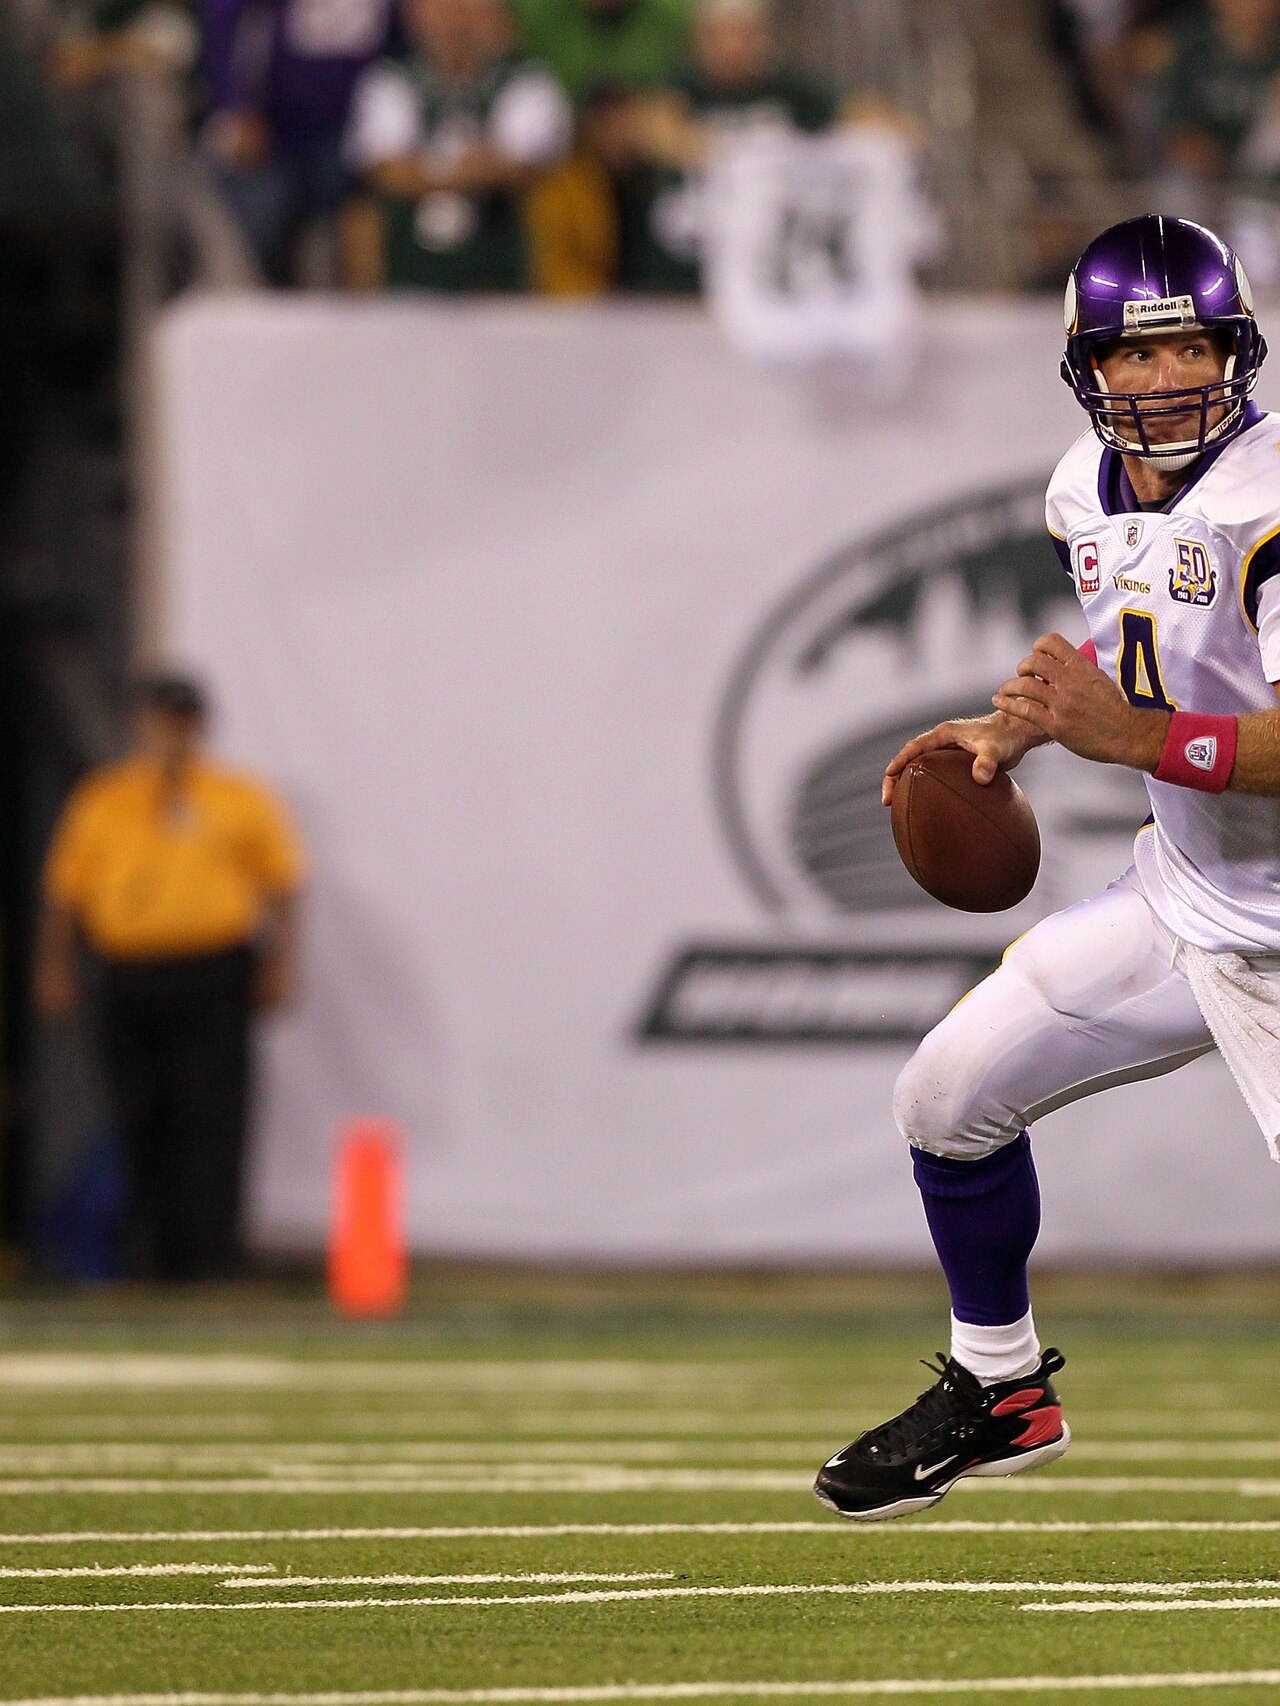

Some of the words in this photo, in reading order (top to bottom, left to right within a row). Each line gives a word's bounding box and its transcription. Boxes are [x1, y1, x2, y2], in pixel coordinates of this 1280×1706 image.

[1140, 301, 1177, 313] Riddell
[1078, 544, 1098, 581] C
[1177, 543, 1207, 585] 50
[1116, 607, 1181, 711] 4
